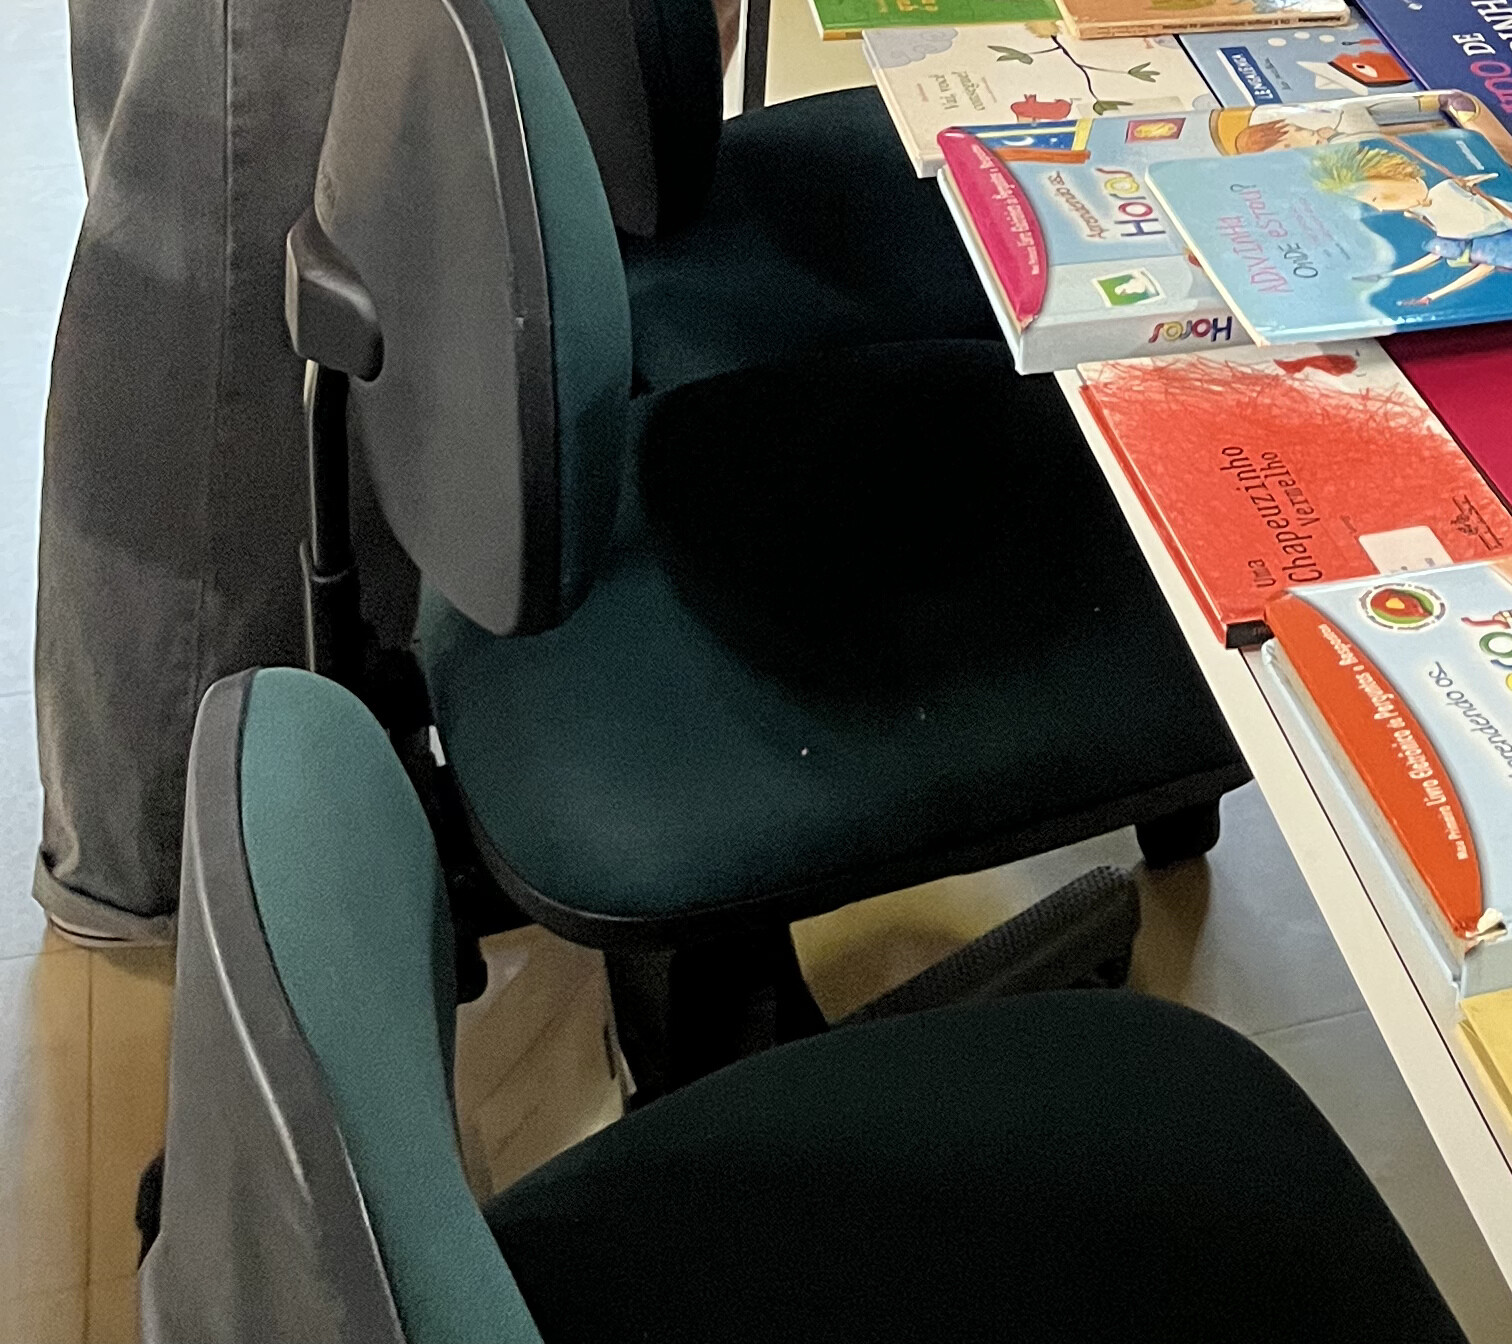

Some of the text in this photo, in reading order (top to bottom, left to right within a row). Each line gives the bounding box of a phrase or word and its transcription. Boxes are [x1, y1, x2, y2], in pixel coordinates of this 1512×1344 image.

[1451, 30, 1492, 57] DE
[1096, 165, 1167, 241] Horas
[1149, 315, 1233, 345] Horas
[1222, 445, 1323, 584] Chapeuzinho
[1246, 558, 1279, 588] Uma
[1351, 663, 1404, 725] Perguntas
[1427, 660, 1456, 694] os
[1415, 775, 1449, 810] Livro
